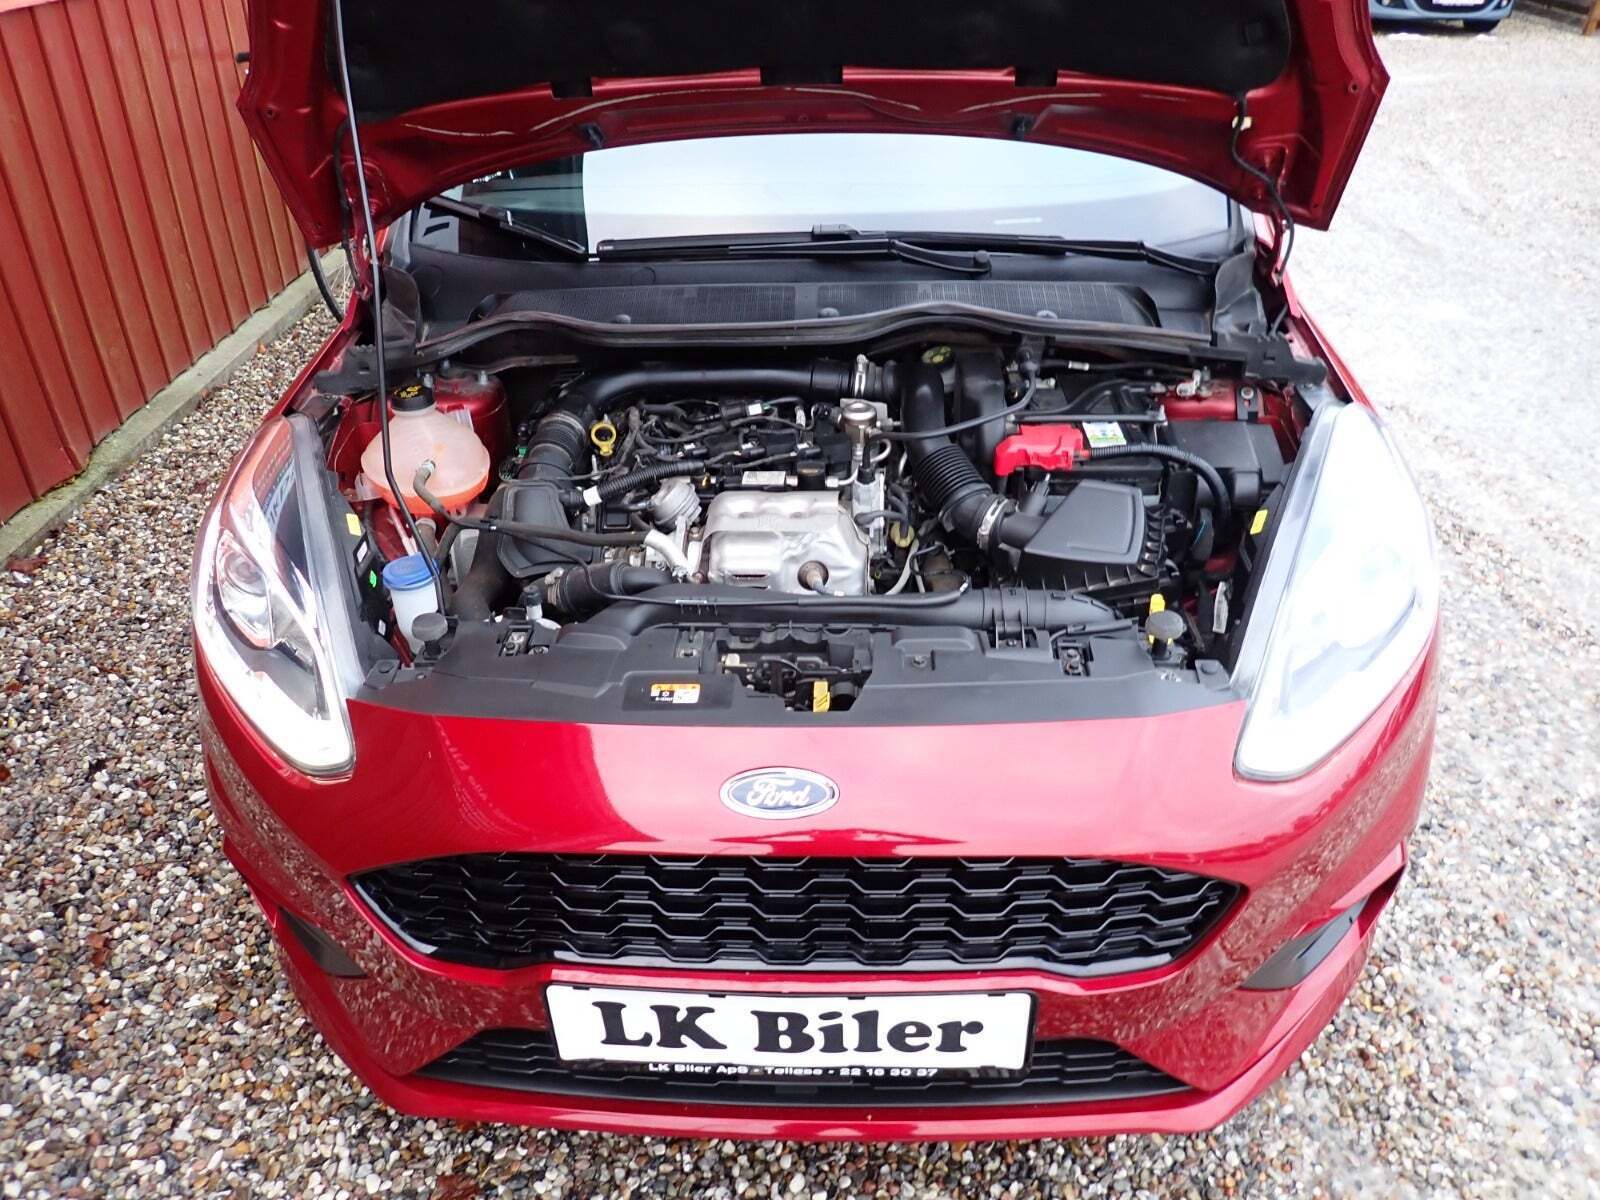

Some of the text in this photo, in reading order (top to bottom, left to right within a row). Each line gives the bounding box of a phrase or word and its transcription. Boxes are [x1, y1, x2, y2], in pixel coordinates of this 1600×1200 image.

[746, 779, 811, 806] Ford
[591, 1000, 985, 1053] LK Biler
[648, 1063, 670, 1072] LK
[674, 1064, 712, 1073] Biler
[716, 1065, 749, 1075] ApS
